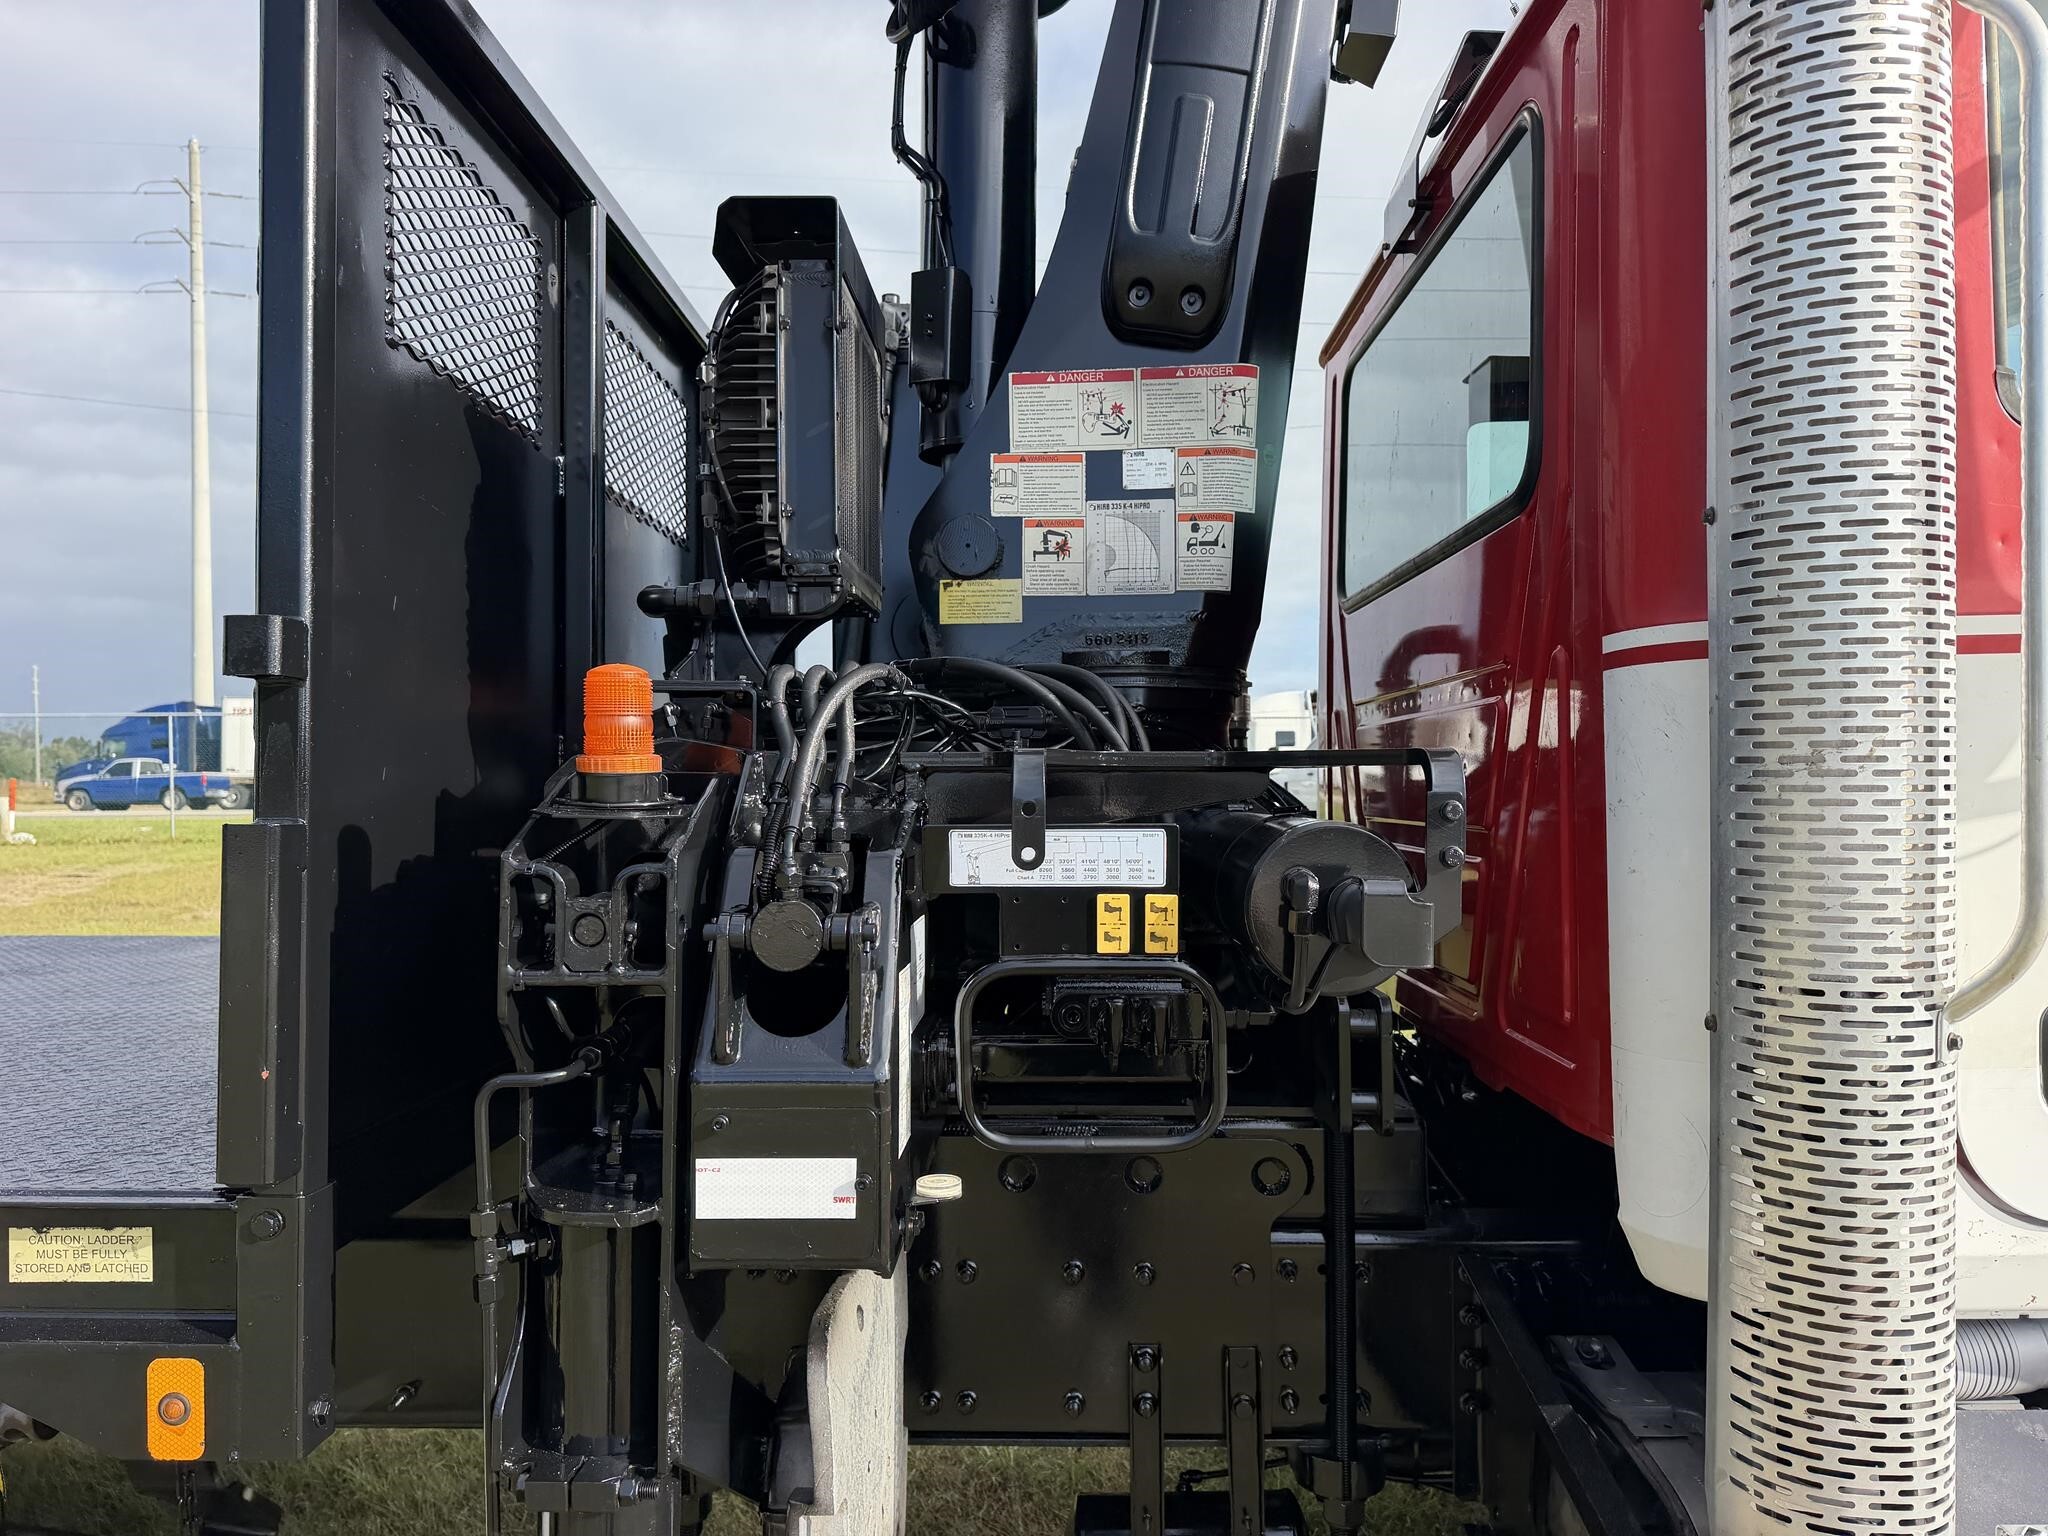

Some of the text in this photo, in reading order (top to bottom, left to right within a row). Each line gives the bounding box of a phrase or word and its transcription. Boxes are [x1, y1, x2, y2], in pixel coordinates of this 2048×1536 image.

[1059, 372, 1104, 382] DANGER
[1188, 367, 1234, 377] DANGER
[1123, 502, 1133, 510] K-4
[832, 1196, 856, 1204] SWRT
[28, 1235, 135, 1246] CAUTION: LADDER
[36, 1249, 128, 1259] MUST BE FULLY
[15, 1263, 148, 1273] STORED AND LATCHED
